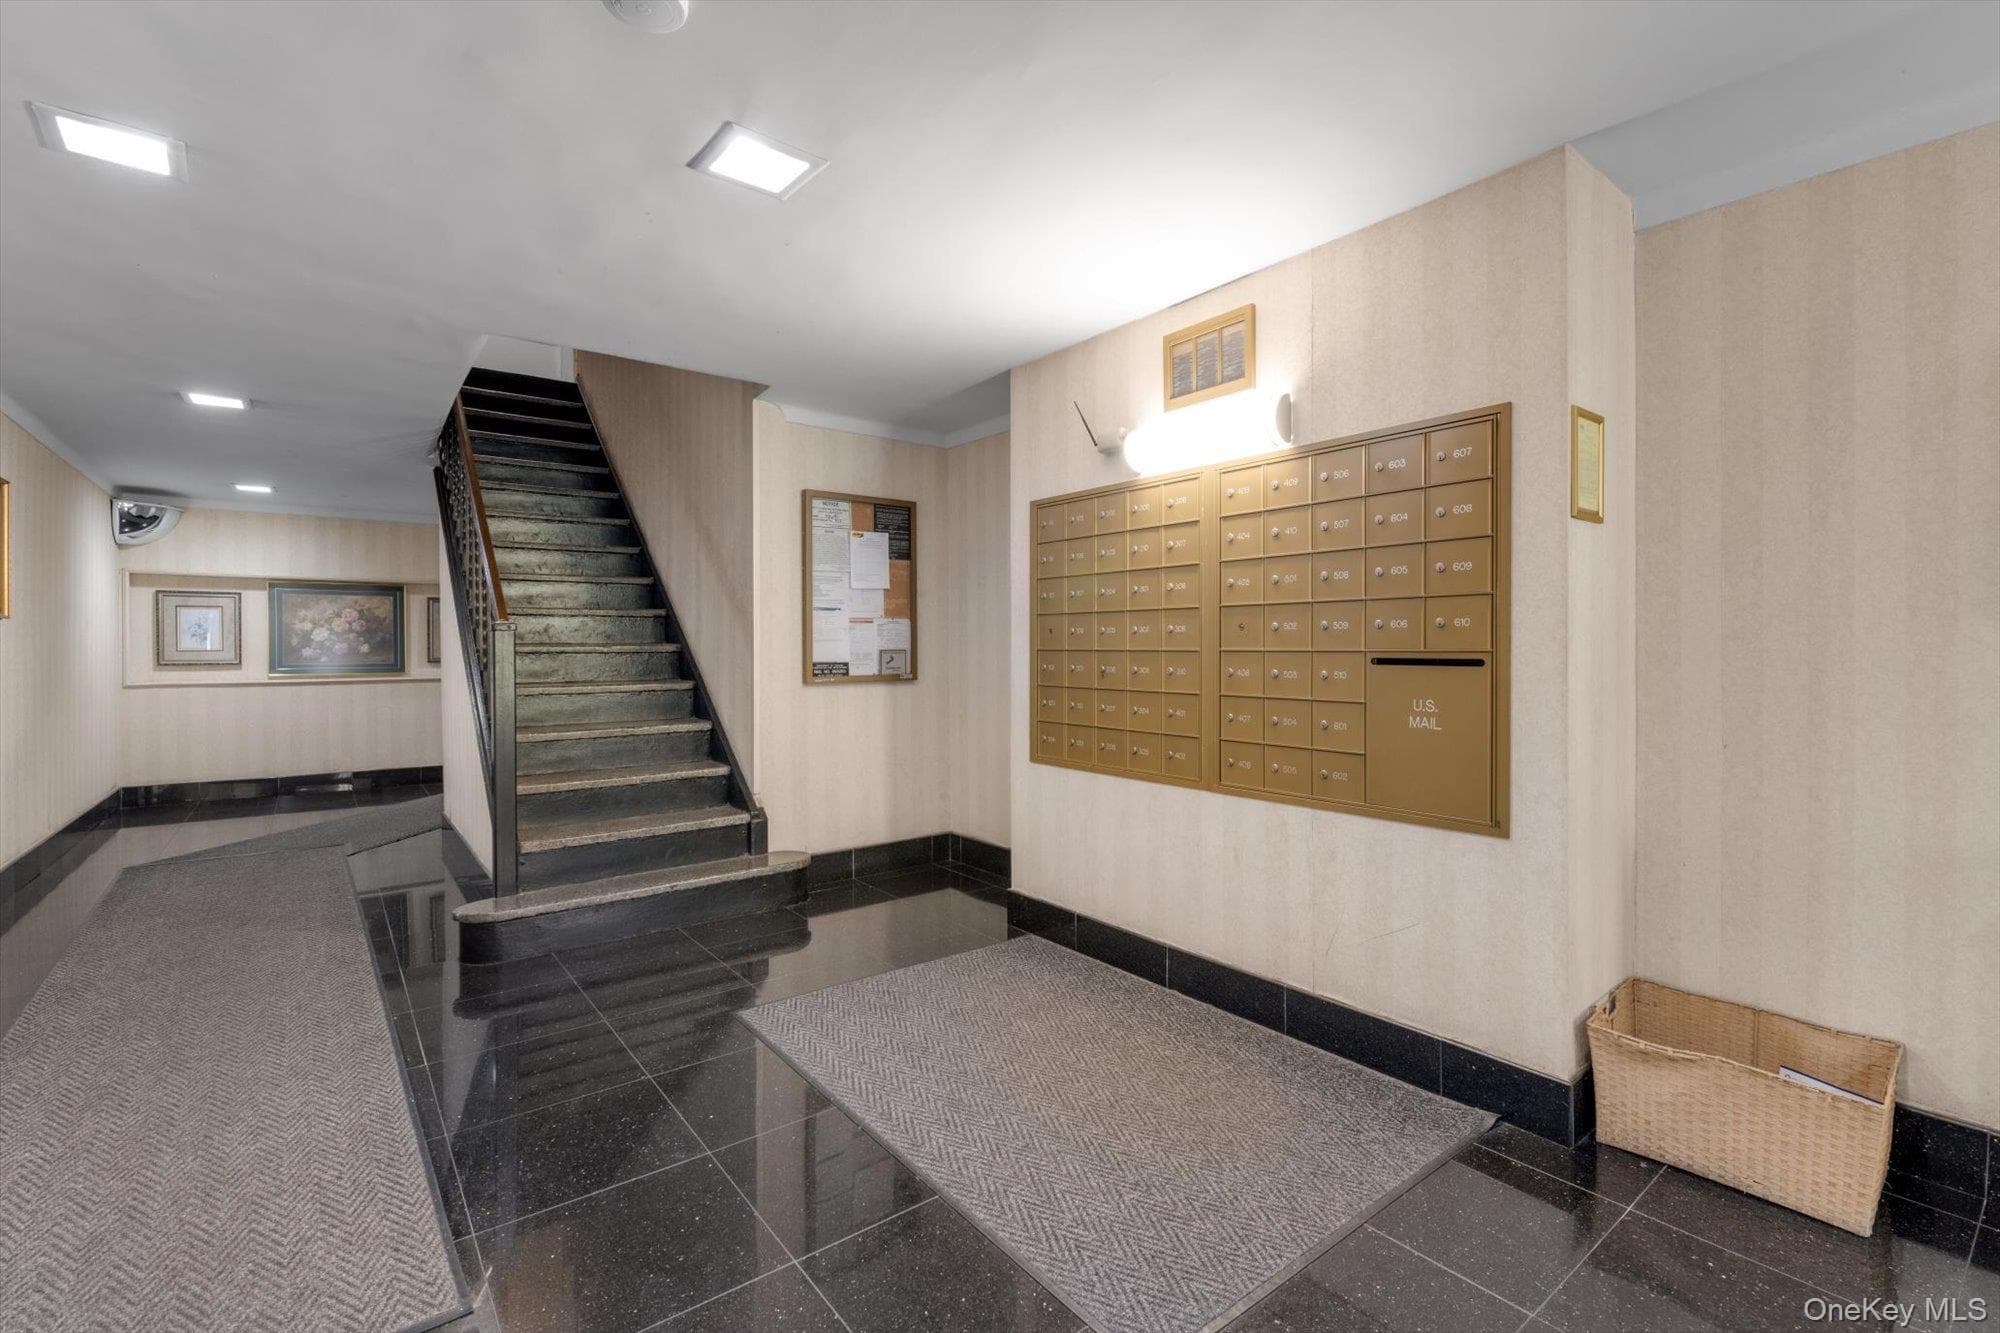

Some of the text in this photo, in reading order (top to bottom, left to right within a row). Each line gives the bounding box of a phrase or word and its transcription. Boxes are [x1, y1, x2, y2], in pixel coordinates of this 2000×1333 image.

[1452, 446, 1472, 458] 607
[1388, 458, 1407, 470] 603
[1452, 504, 1473, 514] 608
[1390, 512, 1408, 523] 604
[1390, 566, 1408, 576] 605
[1452, 562, 1473, 572] 609
[1390, 619, 1408, 629] 606
[1454, 617, 1470, 628] 610
[1413, 699, 1439, 712] U.S.
[1409, 715, 1443, 730] MAIL
[1332, 771, 1348, 782] 602
